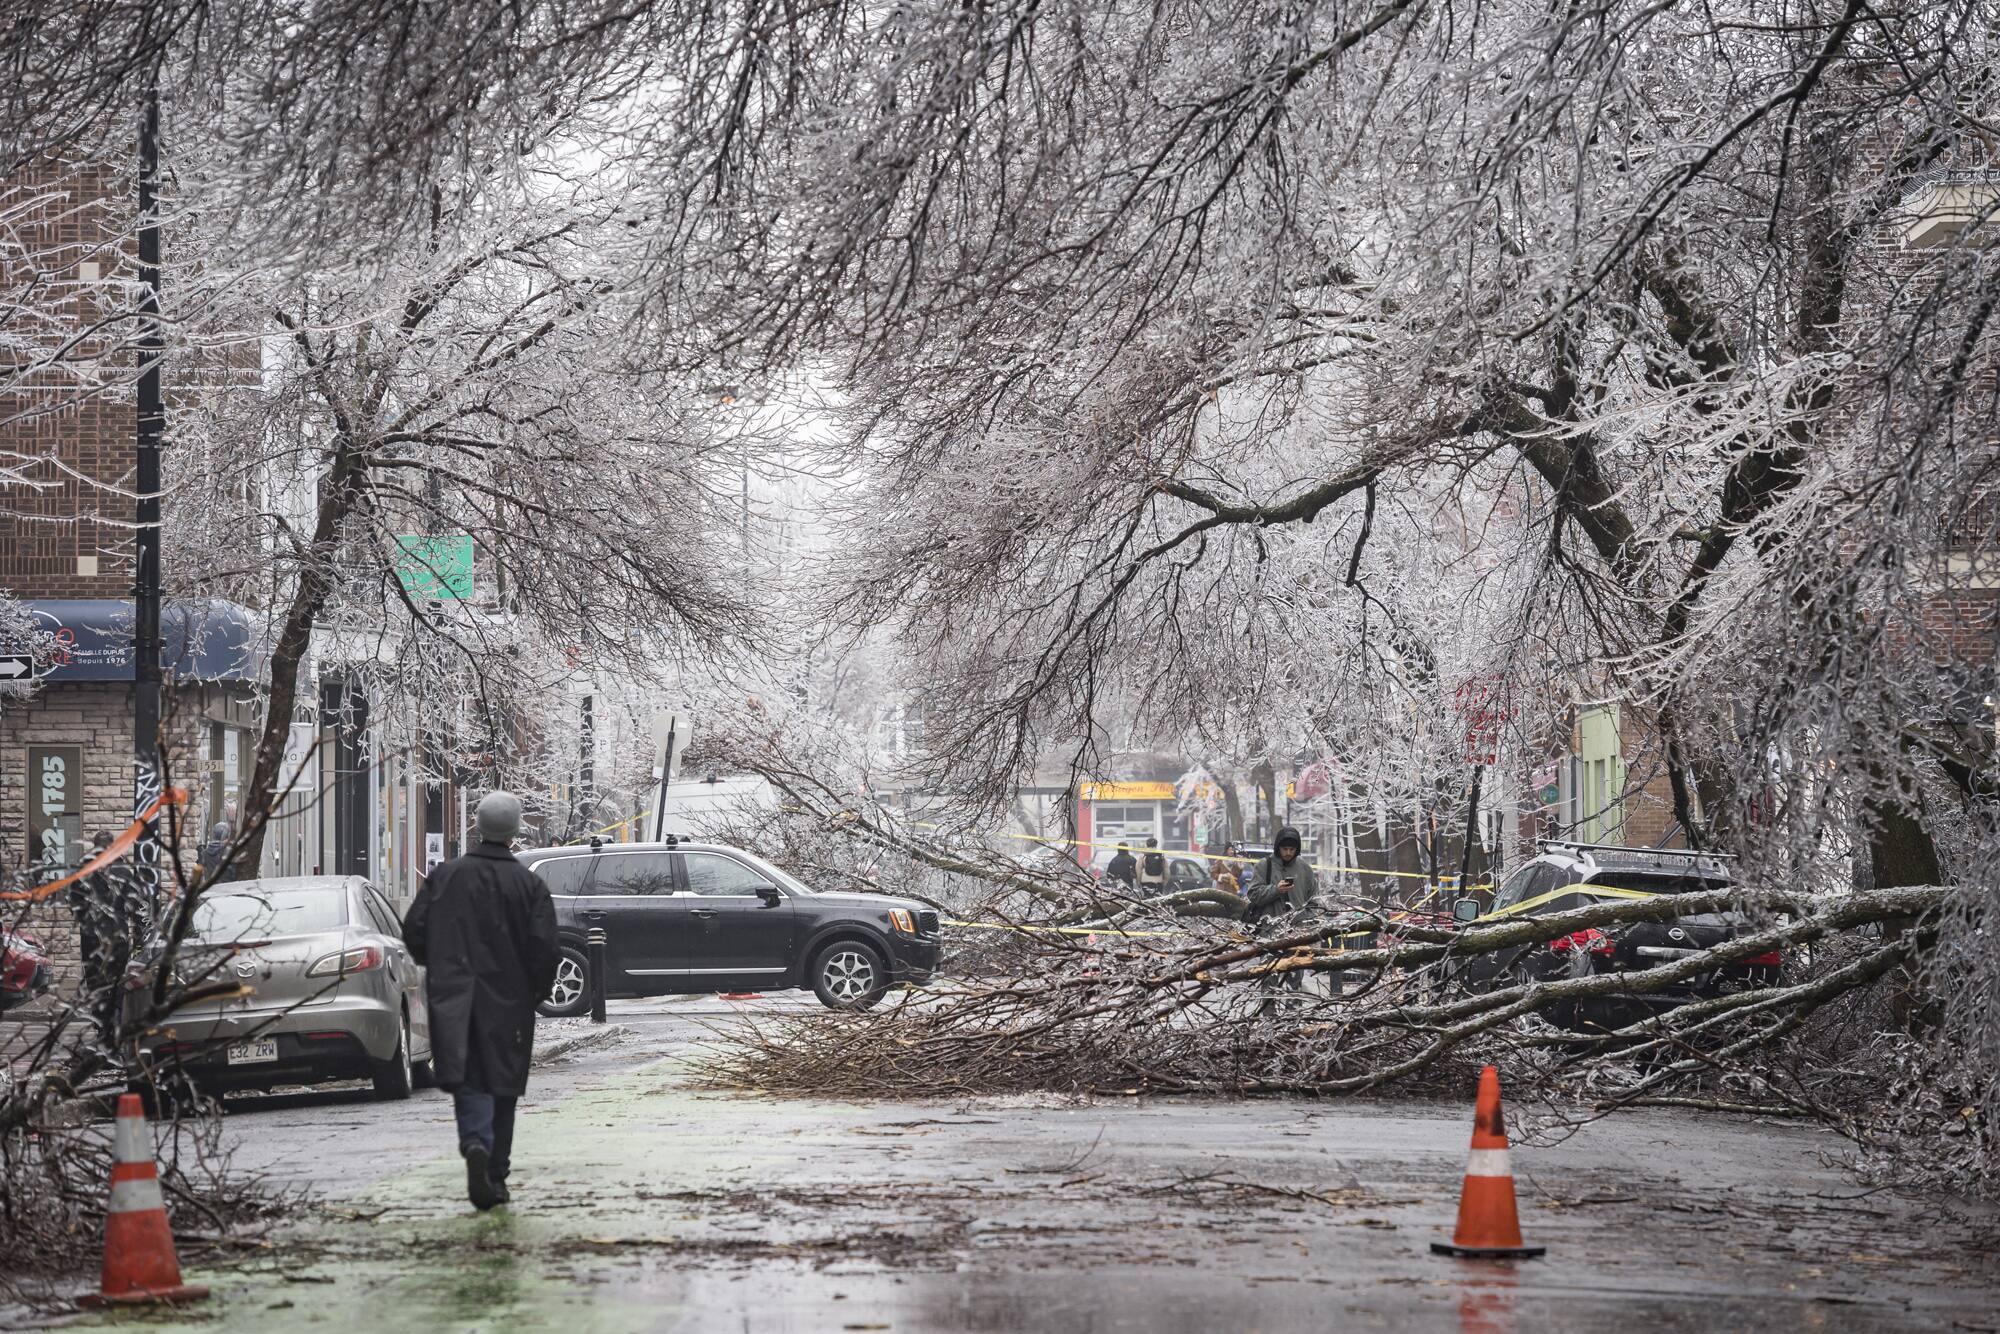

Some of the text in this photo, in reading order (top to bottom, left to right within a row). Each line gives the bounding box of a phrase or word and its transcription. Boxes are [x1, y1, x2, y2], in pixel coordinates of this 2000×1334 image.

[77, 657, 103, 665] depuis
[230, 1043, 275, 1059] E32 ZRW
